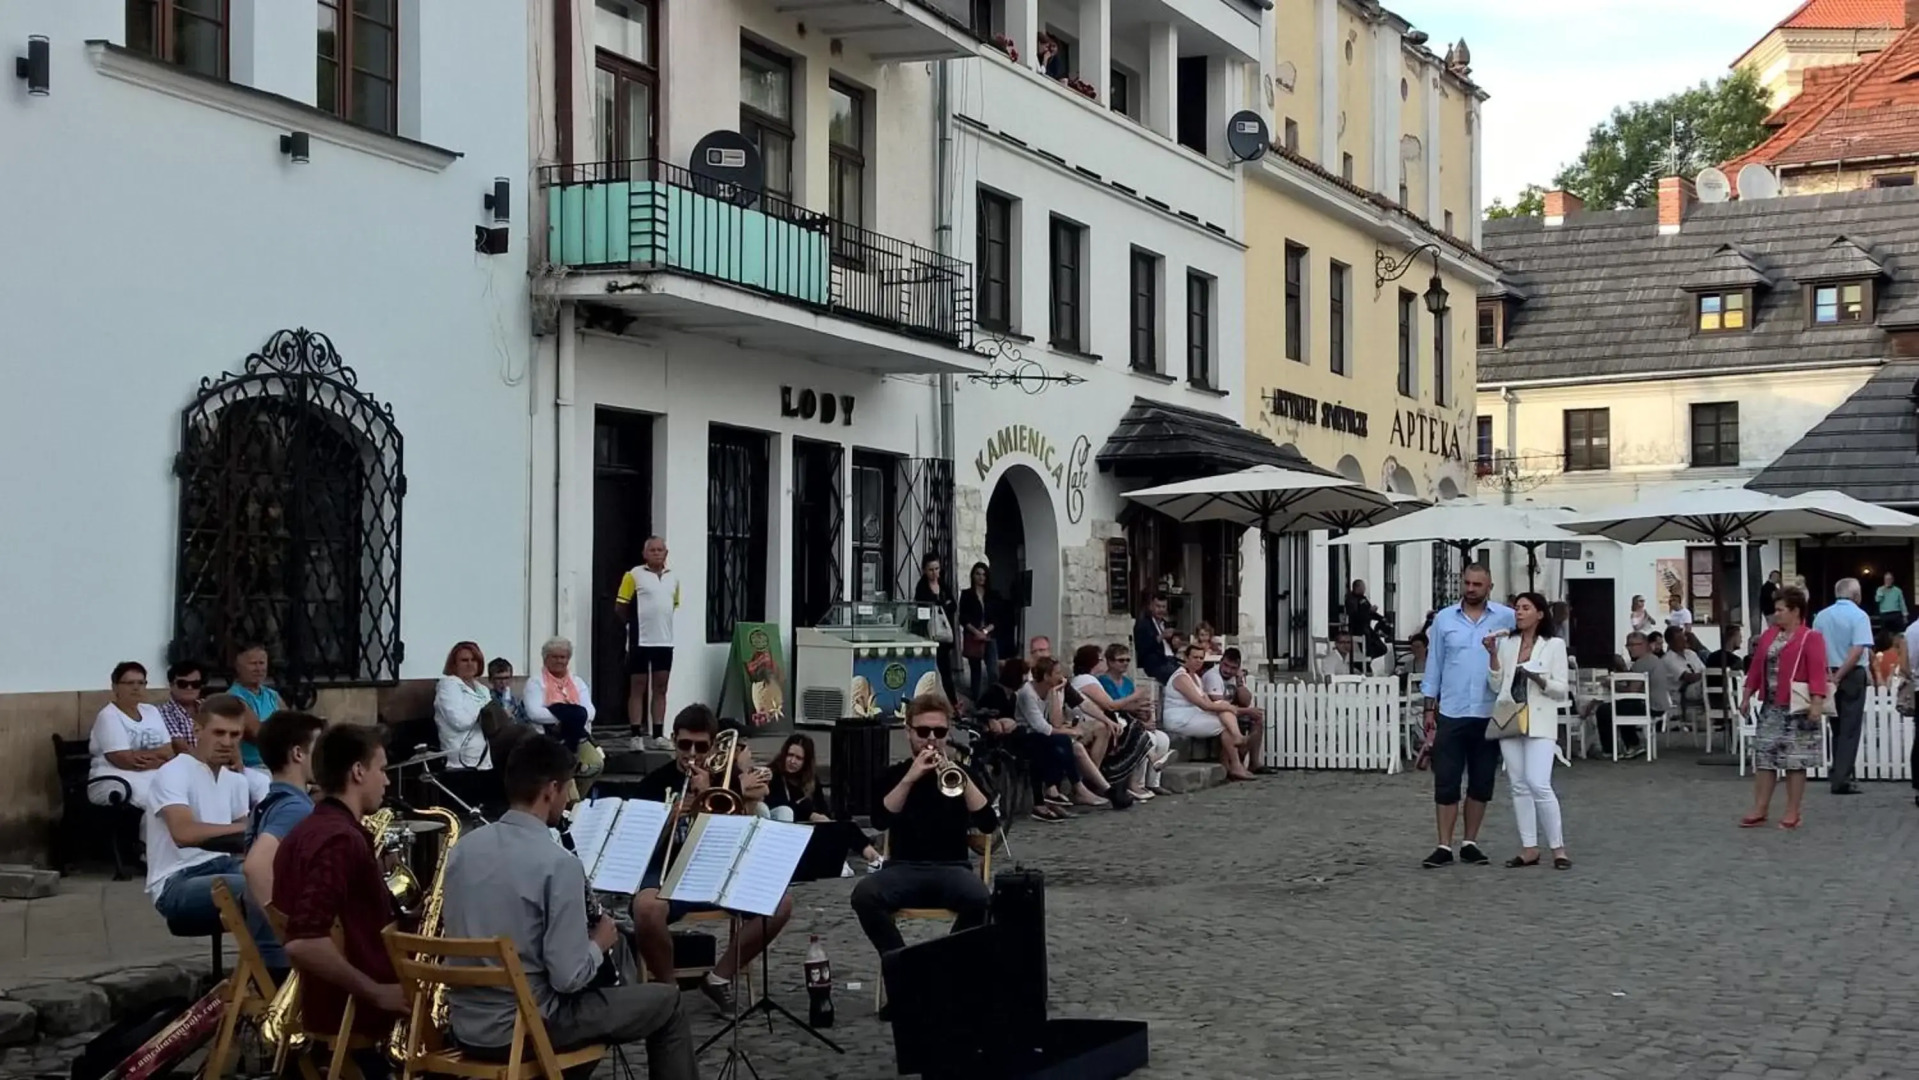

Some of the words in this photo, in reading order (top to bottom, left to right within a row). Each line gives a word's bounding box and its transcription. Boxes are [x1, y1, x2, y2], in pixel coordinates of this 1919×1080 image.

[779, 384, 856, 426] LODY
[974, 424, 1064, 489] KAMIENICA
[1389, 407, 1462, 462] APTEKA
